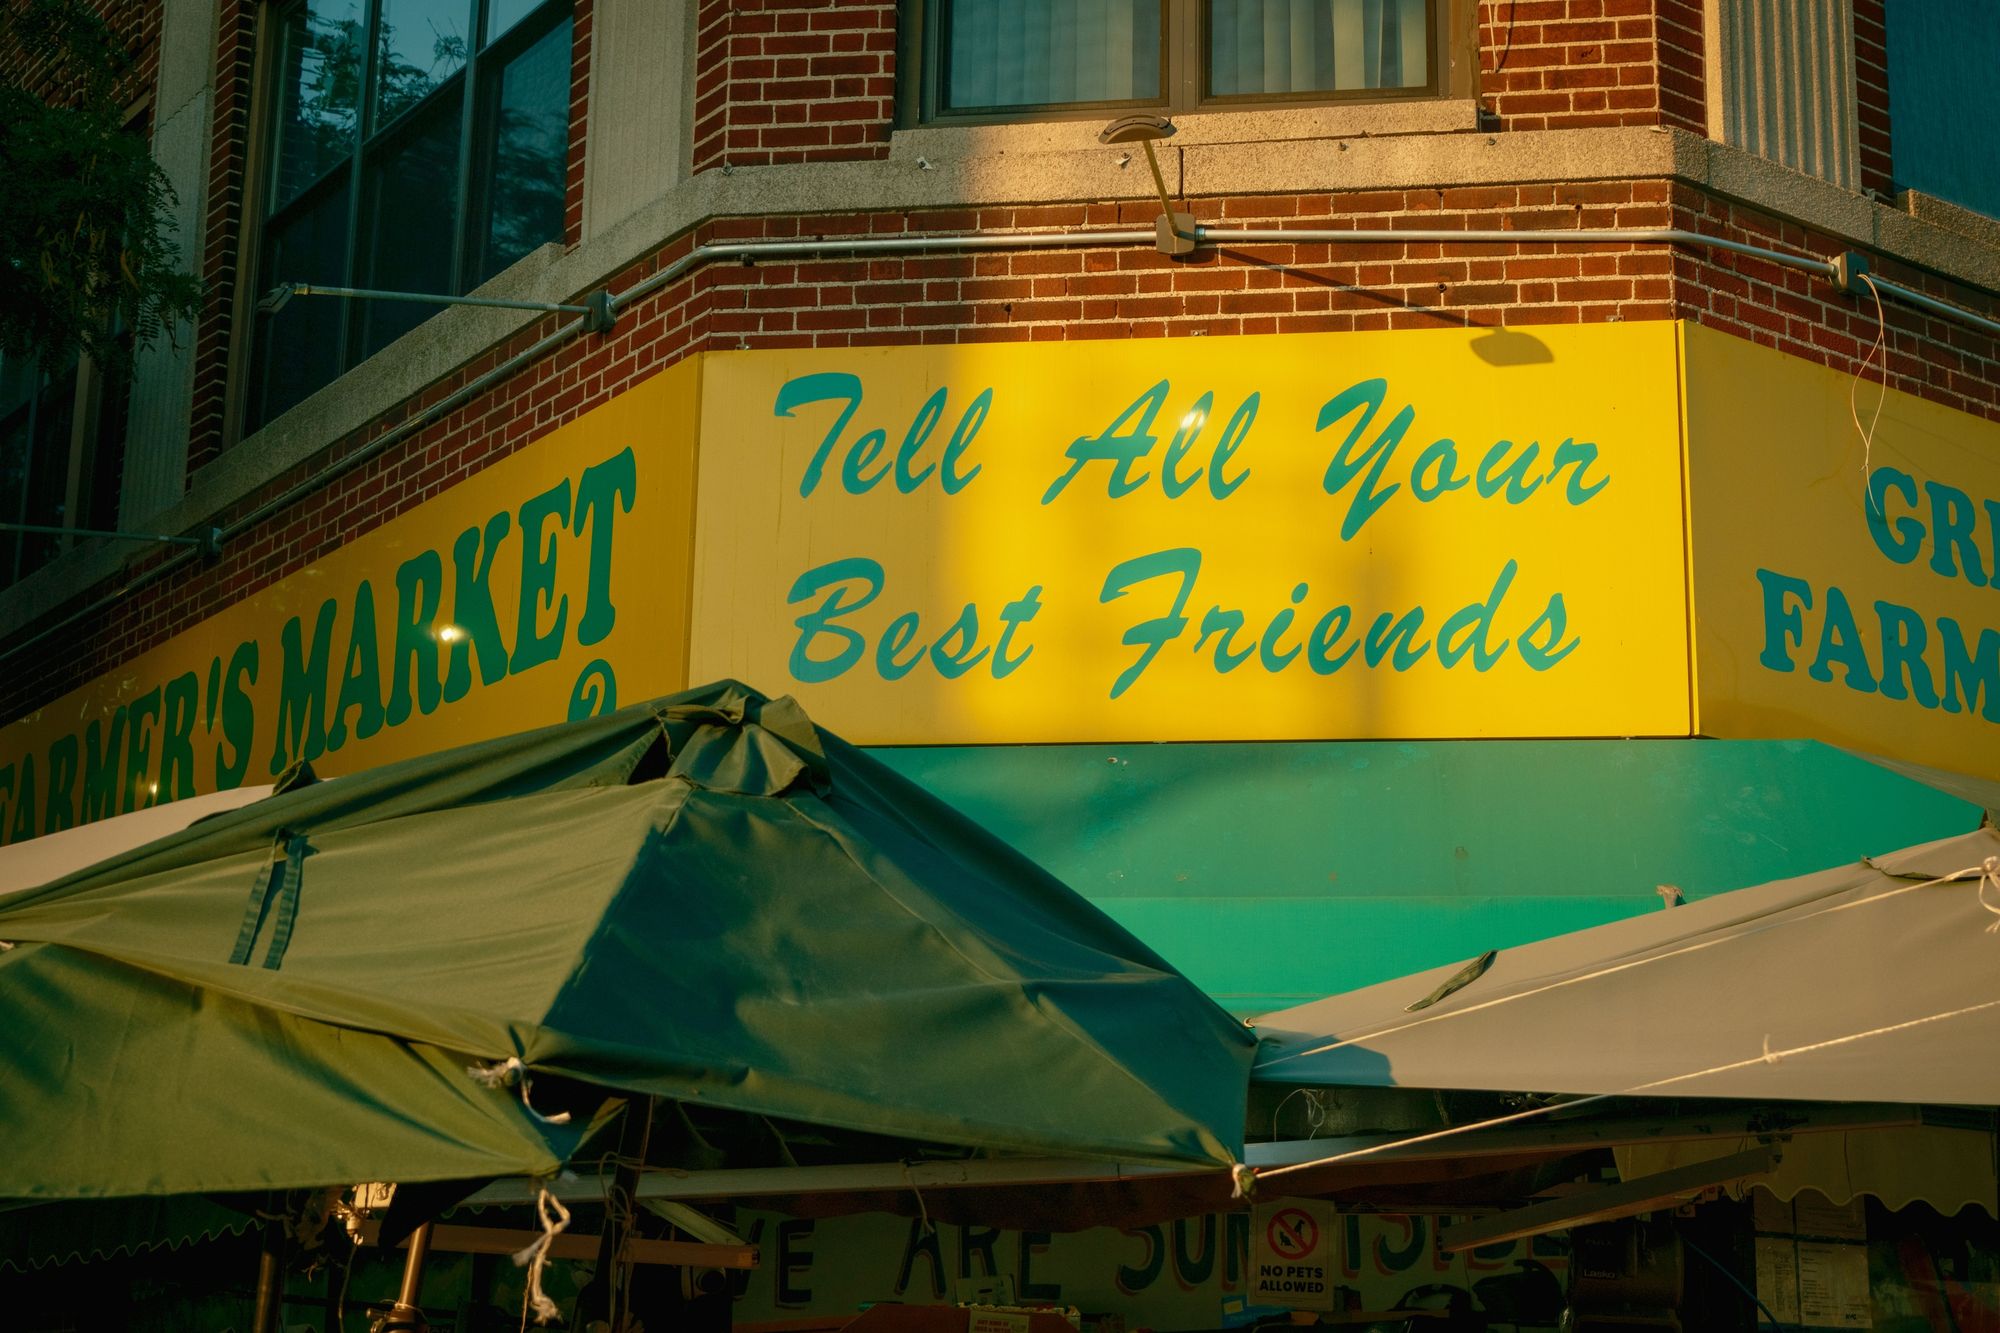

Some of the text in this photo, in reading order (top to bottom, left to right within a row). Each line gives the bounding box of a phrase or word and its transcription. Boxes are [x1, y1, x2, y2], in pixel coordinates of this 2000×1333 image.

[774, 371, 1611, 542] Tell All Your
[269, 446, 637, 772] MARKET
[786, 547, 1581, 700] Best Friends
[1756, 567, 2000, 725] FARM
[1258, 1280, 1325, 1293] ALLOWED
[1260, 1264, 1324, 1279] NO PETS
